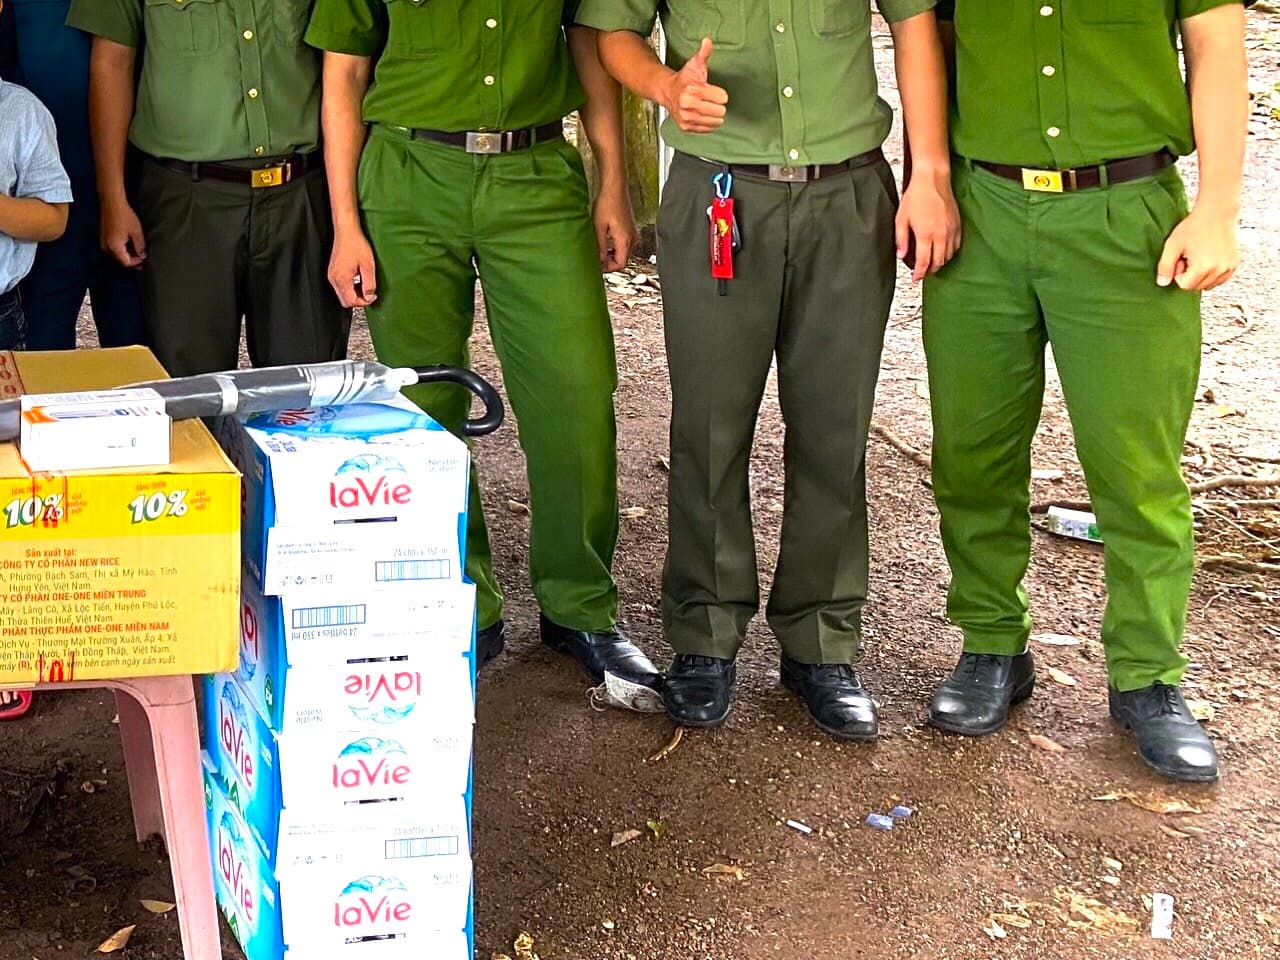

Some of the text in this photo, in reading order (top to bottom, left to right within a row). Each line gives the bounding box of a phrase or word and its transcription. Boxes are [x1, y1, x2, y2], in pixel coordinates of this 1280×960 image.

[127, 488, 190, 525] 10%
[329, 476, 412, 509] laVie
[2, 492, 65, 529] 10%
[24, 560, 35, 568] TY
[80, 558, 99, 567] NEW
[100, 557, 120, 566] RICE
[52, 591, 91, 601] ONE-ONE
[117, 589, 147, 599] TRUNG
[84, 623, 123, 633] ONE-ONE
[149, 621, 169, 630] NAM
[332, 758, 410, 789] laVie
[334, 895, 412, 927] laVie
